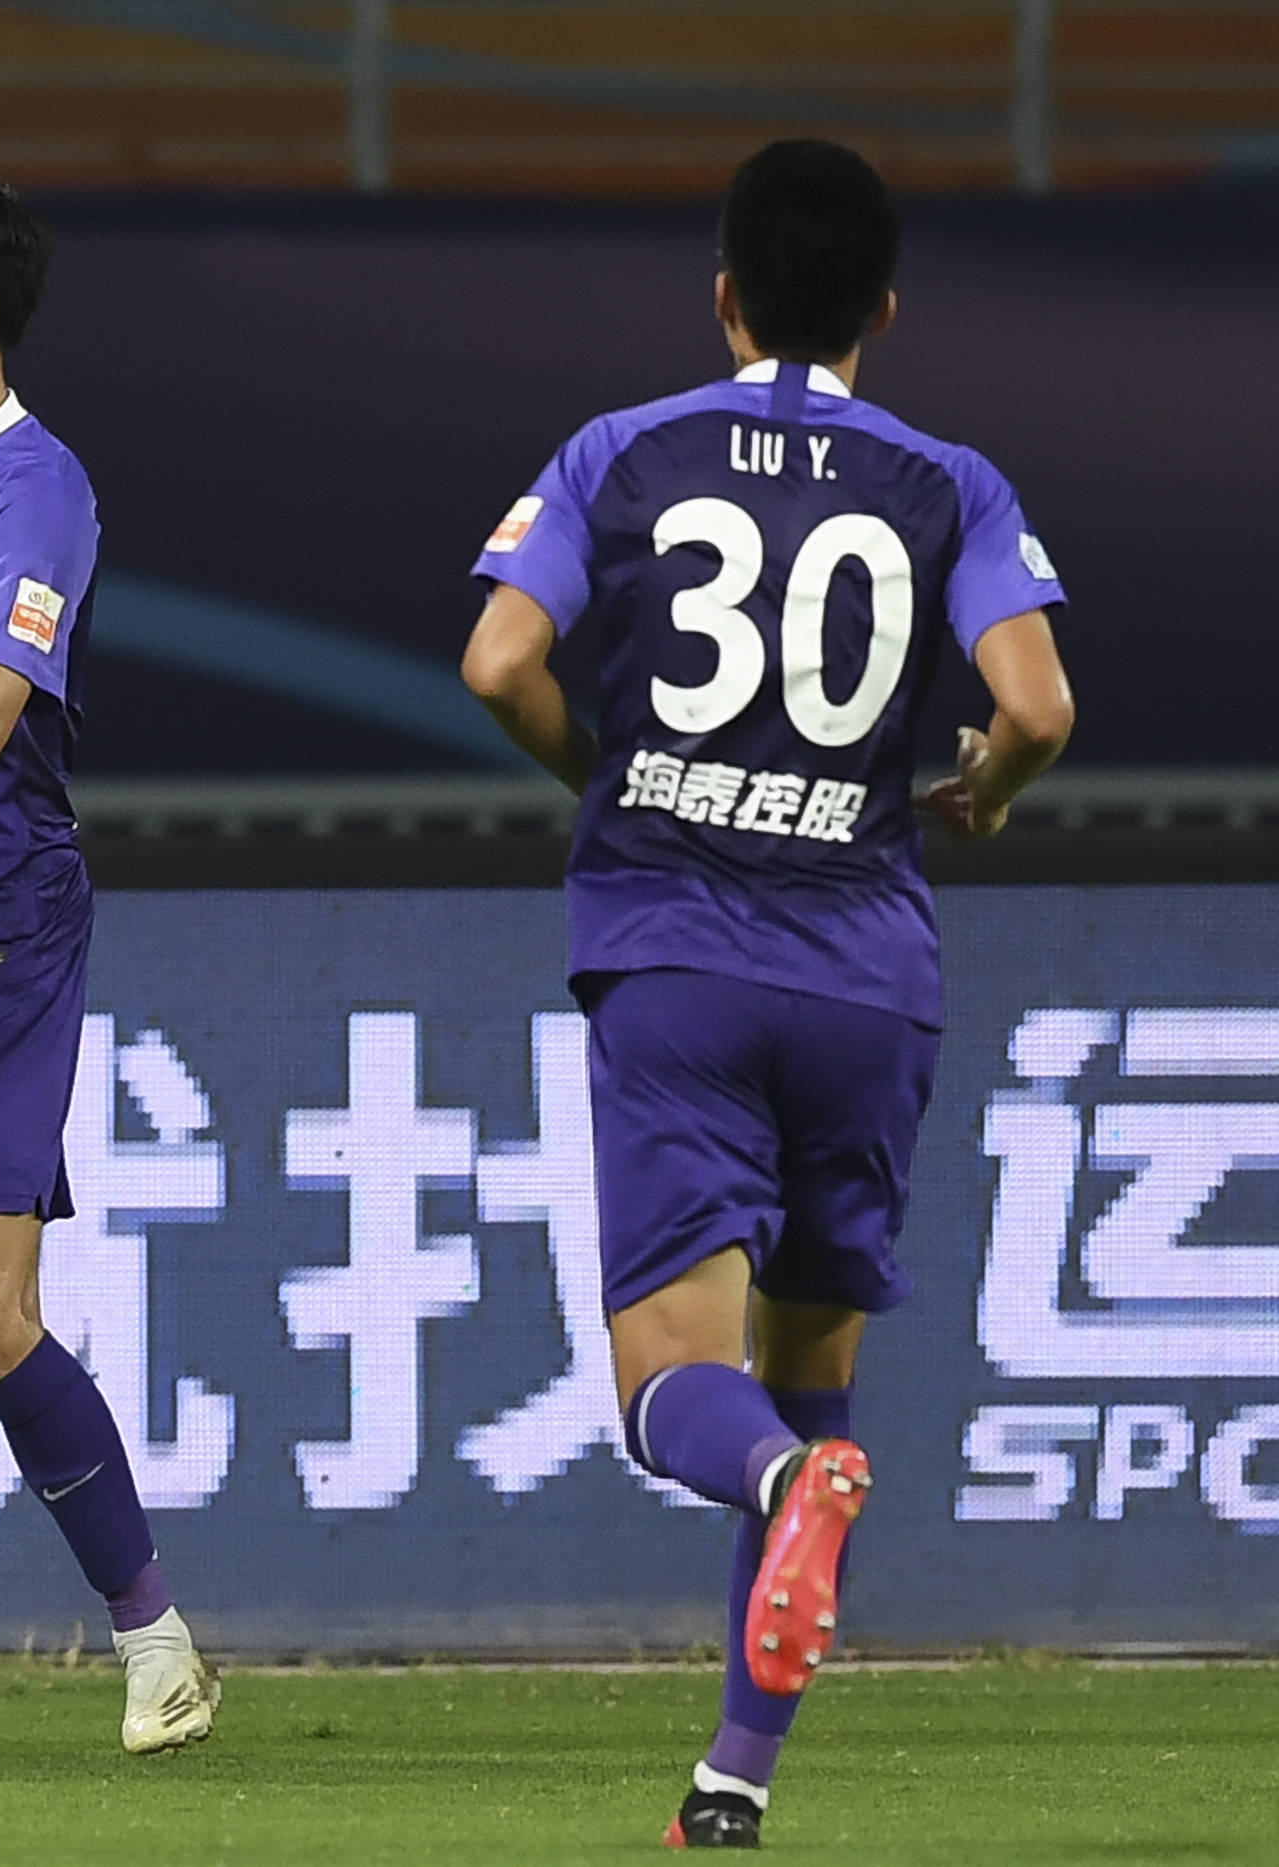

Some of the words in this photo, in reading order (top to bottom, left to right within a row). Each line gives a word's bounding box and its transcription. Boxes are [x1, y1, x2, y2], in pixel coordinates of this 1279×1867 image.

[730, 423, 785, 476] LIU
[807, 435, 837, 480] Y.
[650, 496, 914, 748] 30
[617, 749, 869, 843] 海泰控股
